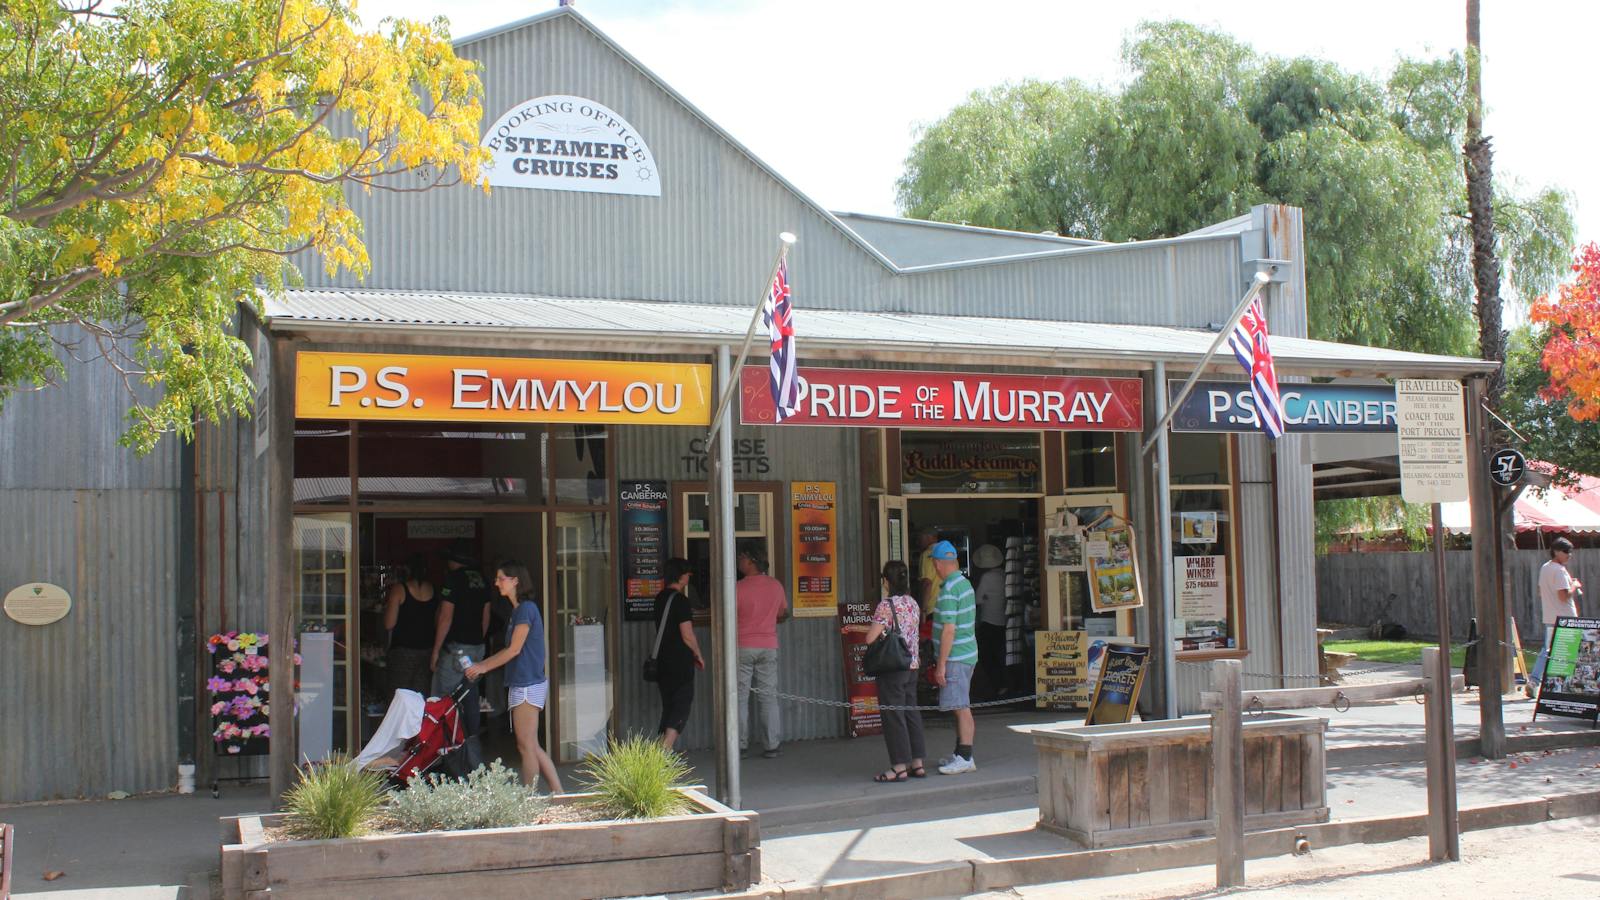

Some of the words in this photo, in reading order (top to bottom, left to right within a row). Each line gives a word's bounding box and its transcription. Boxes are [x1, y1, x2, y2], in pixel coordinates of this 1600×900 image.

[488, 101, 573, 152] BOOKING
[579, 104, 646, 163] OFFICE
[505, 136, 628, 160] STEAMER
[513, 157, 619, 180] CRUISES
[329, 365, 424, 409] P.S.
[916, 386, 939, 402] OF
[1400, 380, 1459, 392] TRAVELLERS
[952, 381, 1113, 424] MURRAY
[1280, 391, 1398, 425] CANBER
[911, 403, 945, 420] THE
[1404, 412, 1431, 421] COACH
[1434, 412, 1455, 421] TOUR
[1401, 427, 1421, 437] PORT
[1424, 428, 1460, 437] PRECINCT
[689, 438, 766, 455] CISE
[681, 456, 770, 474] TICETS
[1497, 455, 1516, 472] 57
[620, 491, 668, 500] CANBERRA
[794, 493, 833, 501] EMMYLOU
[1186, 557, 1215, 568] WHARF
[1186, 568, 1216, 579] WINERY
[1185, 581, 1196, 590] $75
[847, 604, 871, 612] PRIDE
[1103, 671, 1137, 686] TICKETS
